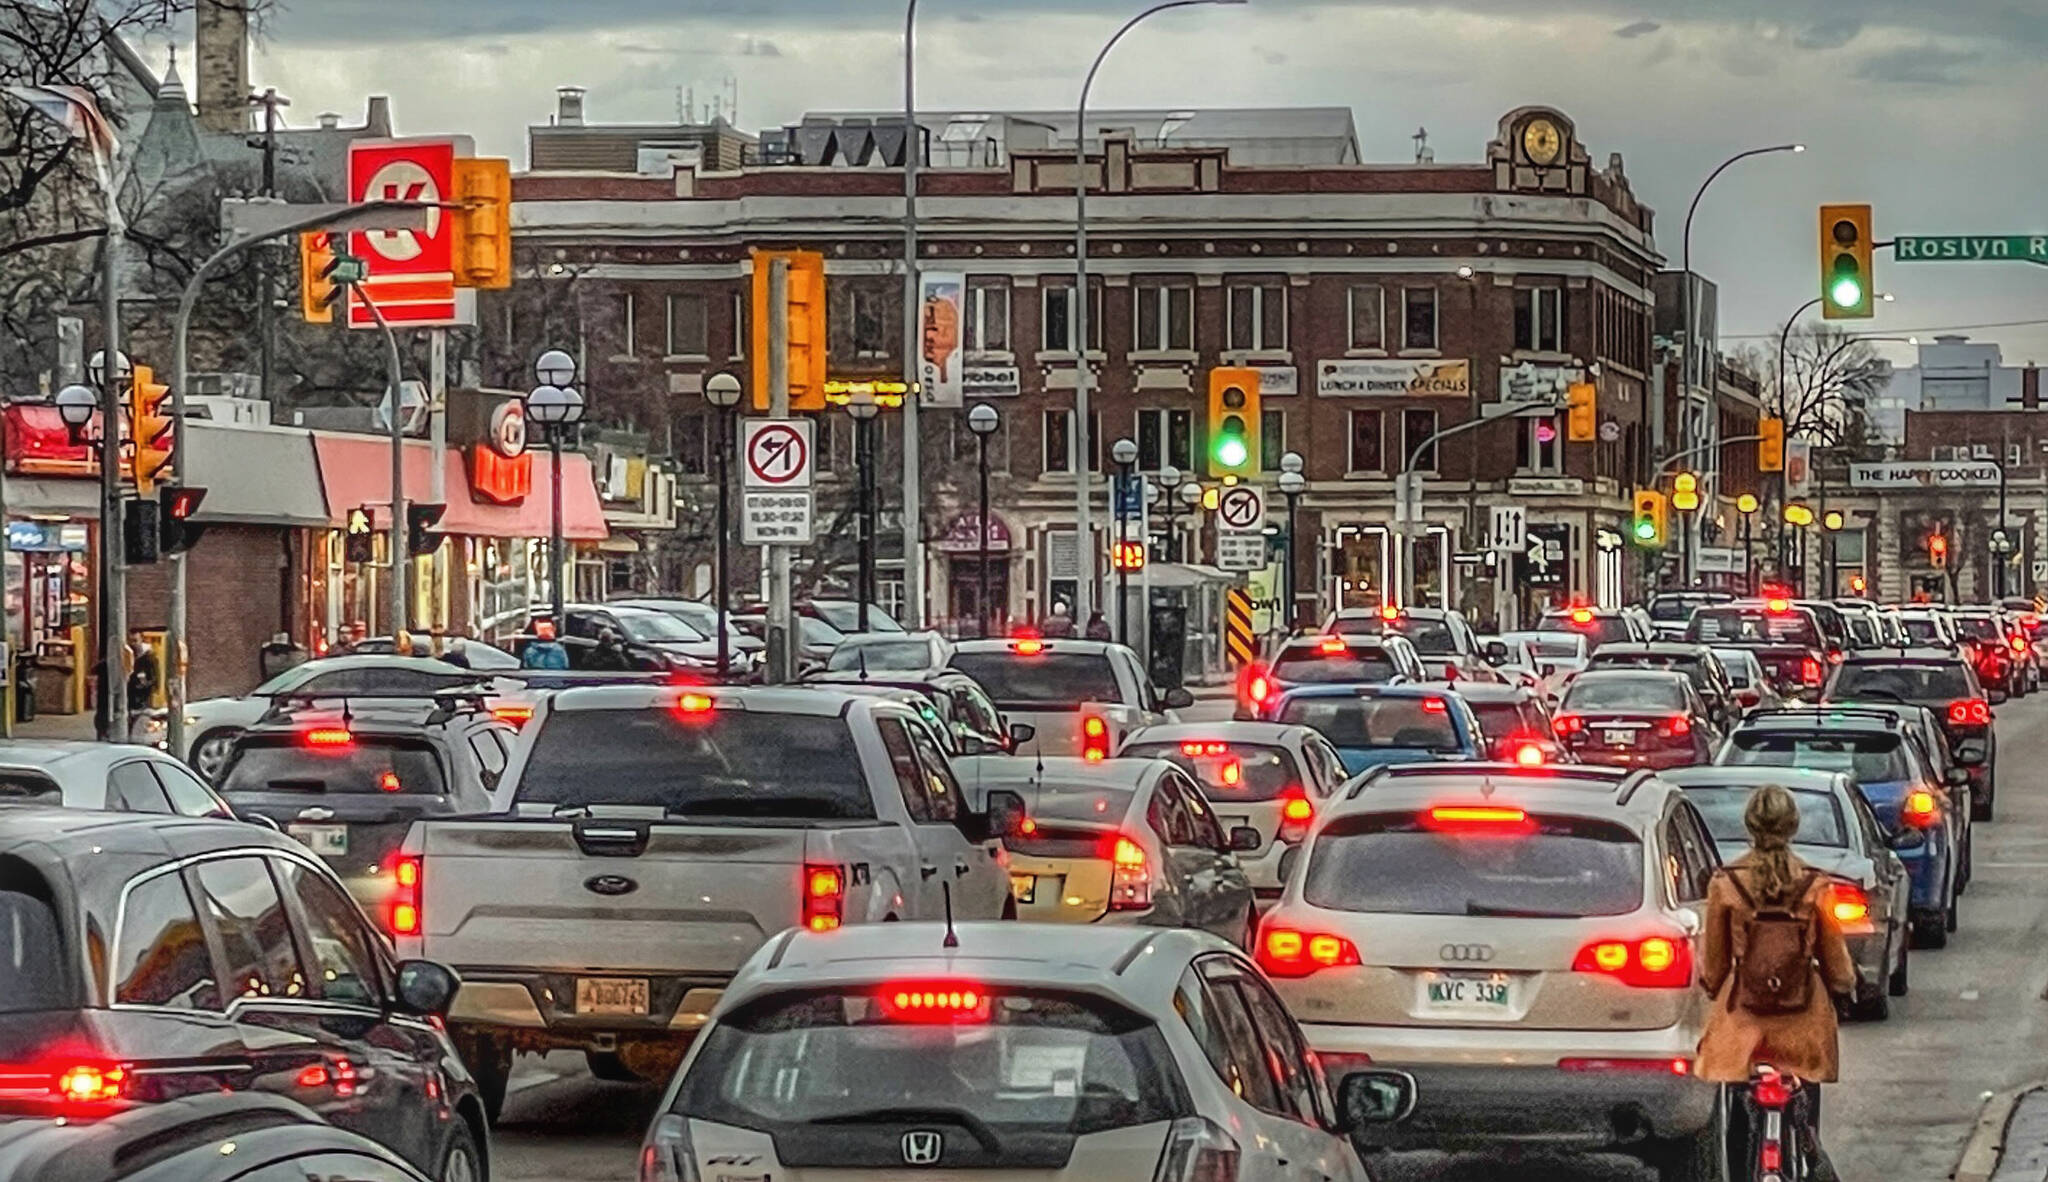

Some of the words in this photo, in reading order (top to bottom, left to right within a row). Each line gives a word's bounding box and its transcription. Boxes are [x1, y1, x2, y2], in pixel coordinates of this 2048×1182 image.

[1900, 238, 2009, 259] Roslyn
[1320, 381, 1358, 391] LUNCH
[1367, 381, 1408, 392] DINNER
[1410, 379, 1467, 392] SPECIALS
[1858, 469, 1885, 481] THE
[1938, 468, 1998, 481] COOKER
[1475, 983, 1505, 1002] 339
